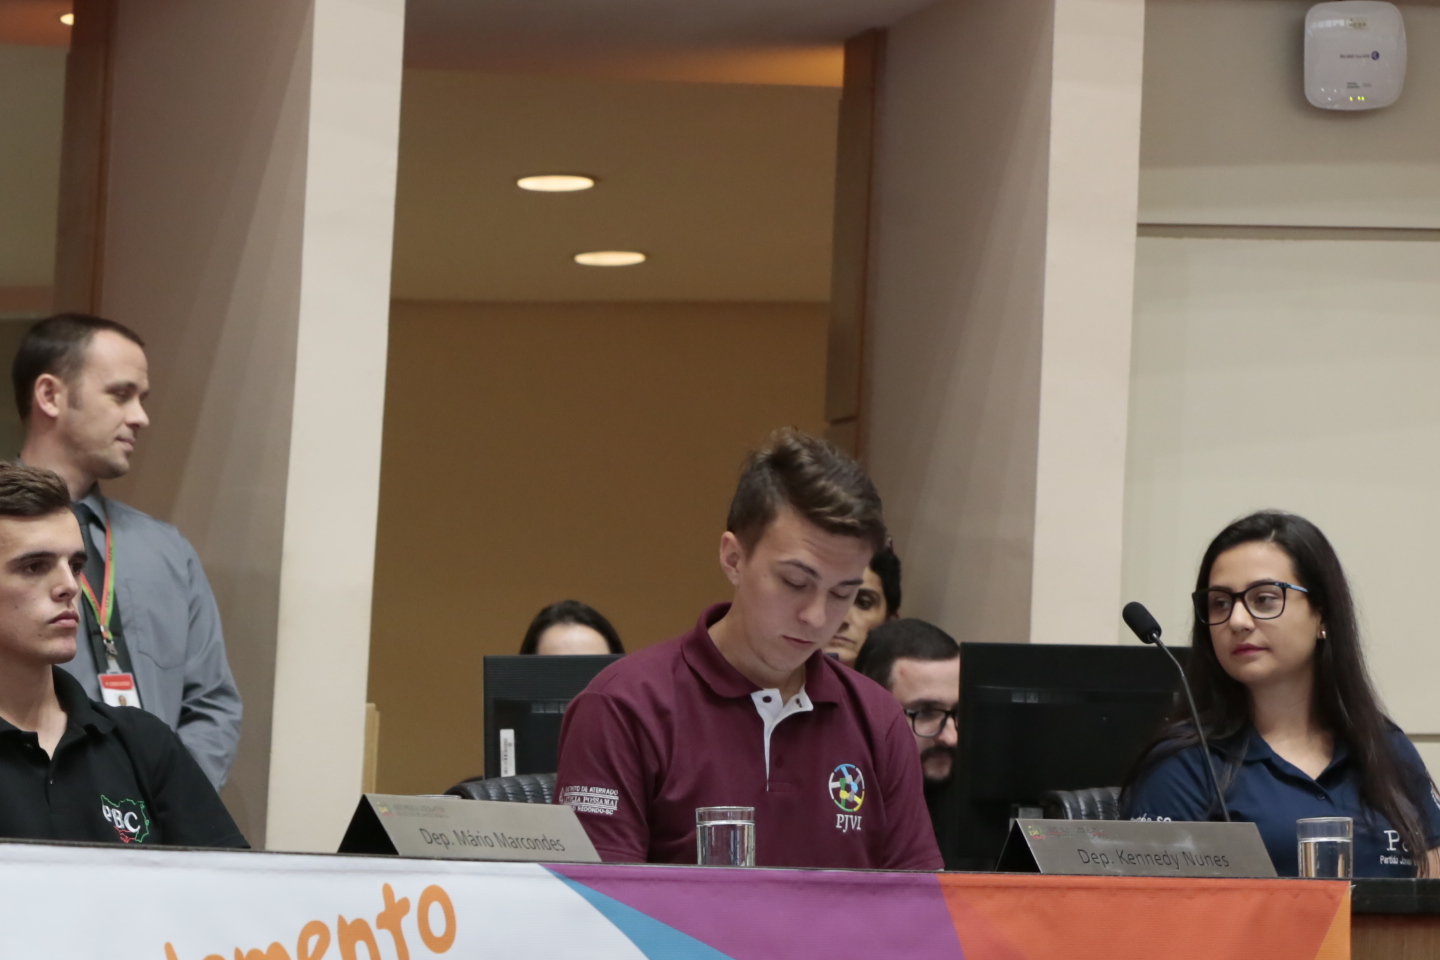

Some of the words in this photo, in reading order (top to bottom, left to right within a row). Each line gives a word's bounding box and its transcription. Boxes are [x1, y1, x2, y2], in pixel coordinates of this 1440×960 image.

[835, 813, 863, 833] PJVI
[419, 828, 455, 850] Dep.
[453, 829, 495, 848] Mário
[493, 832, 566, 852] Marcondes
[1077, 849, 1114, 868] Dep.
[1115, 850, 1180, 870] Kennedy
[1181, 851, 1230, 868] Nunes
